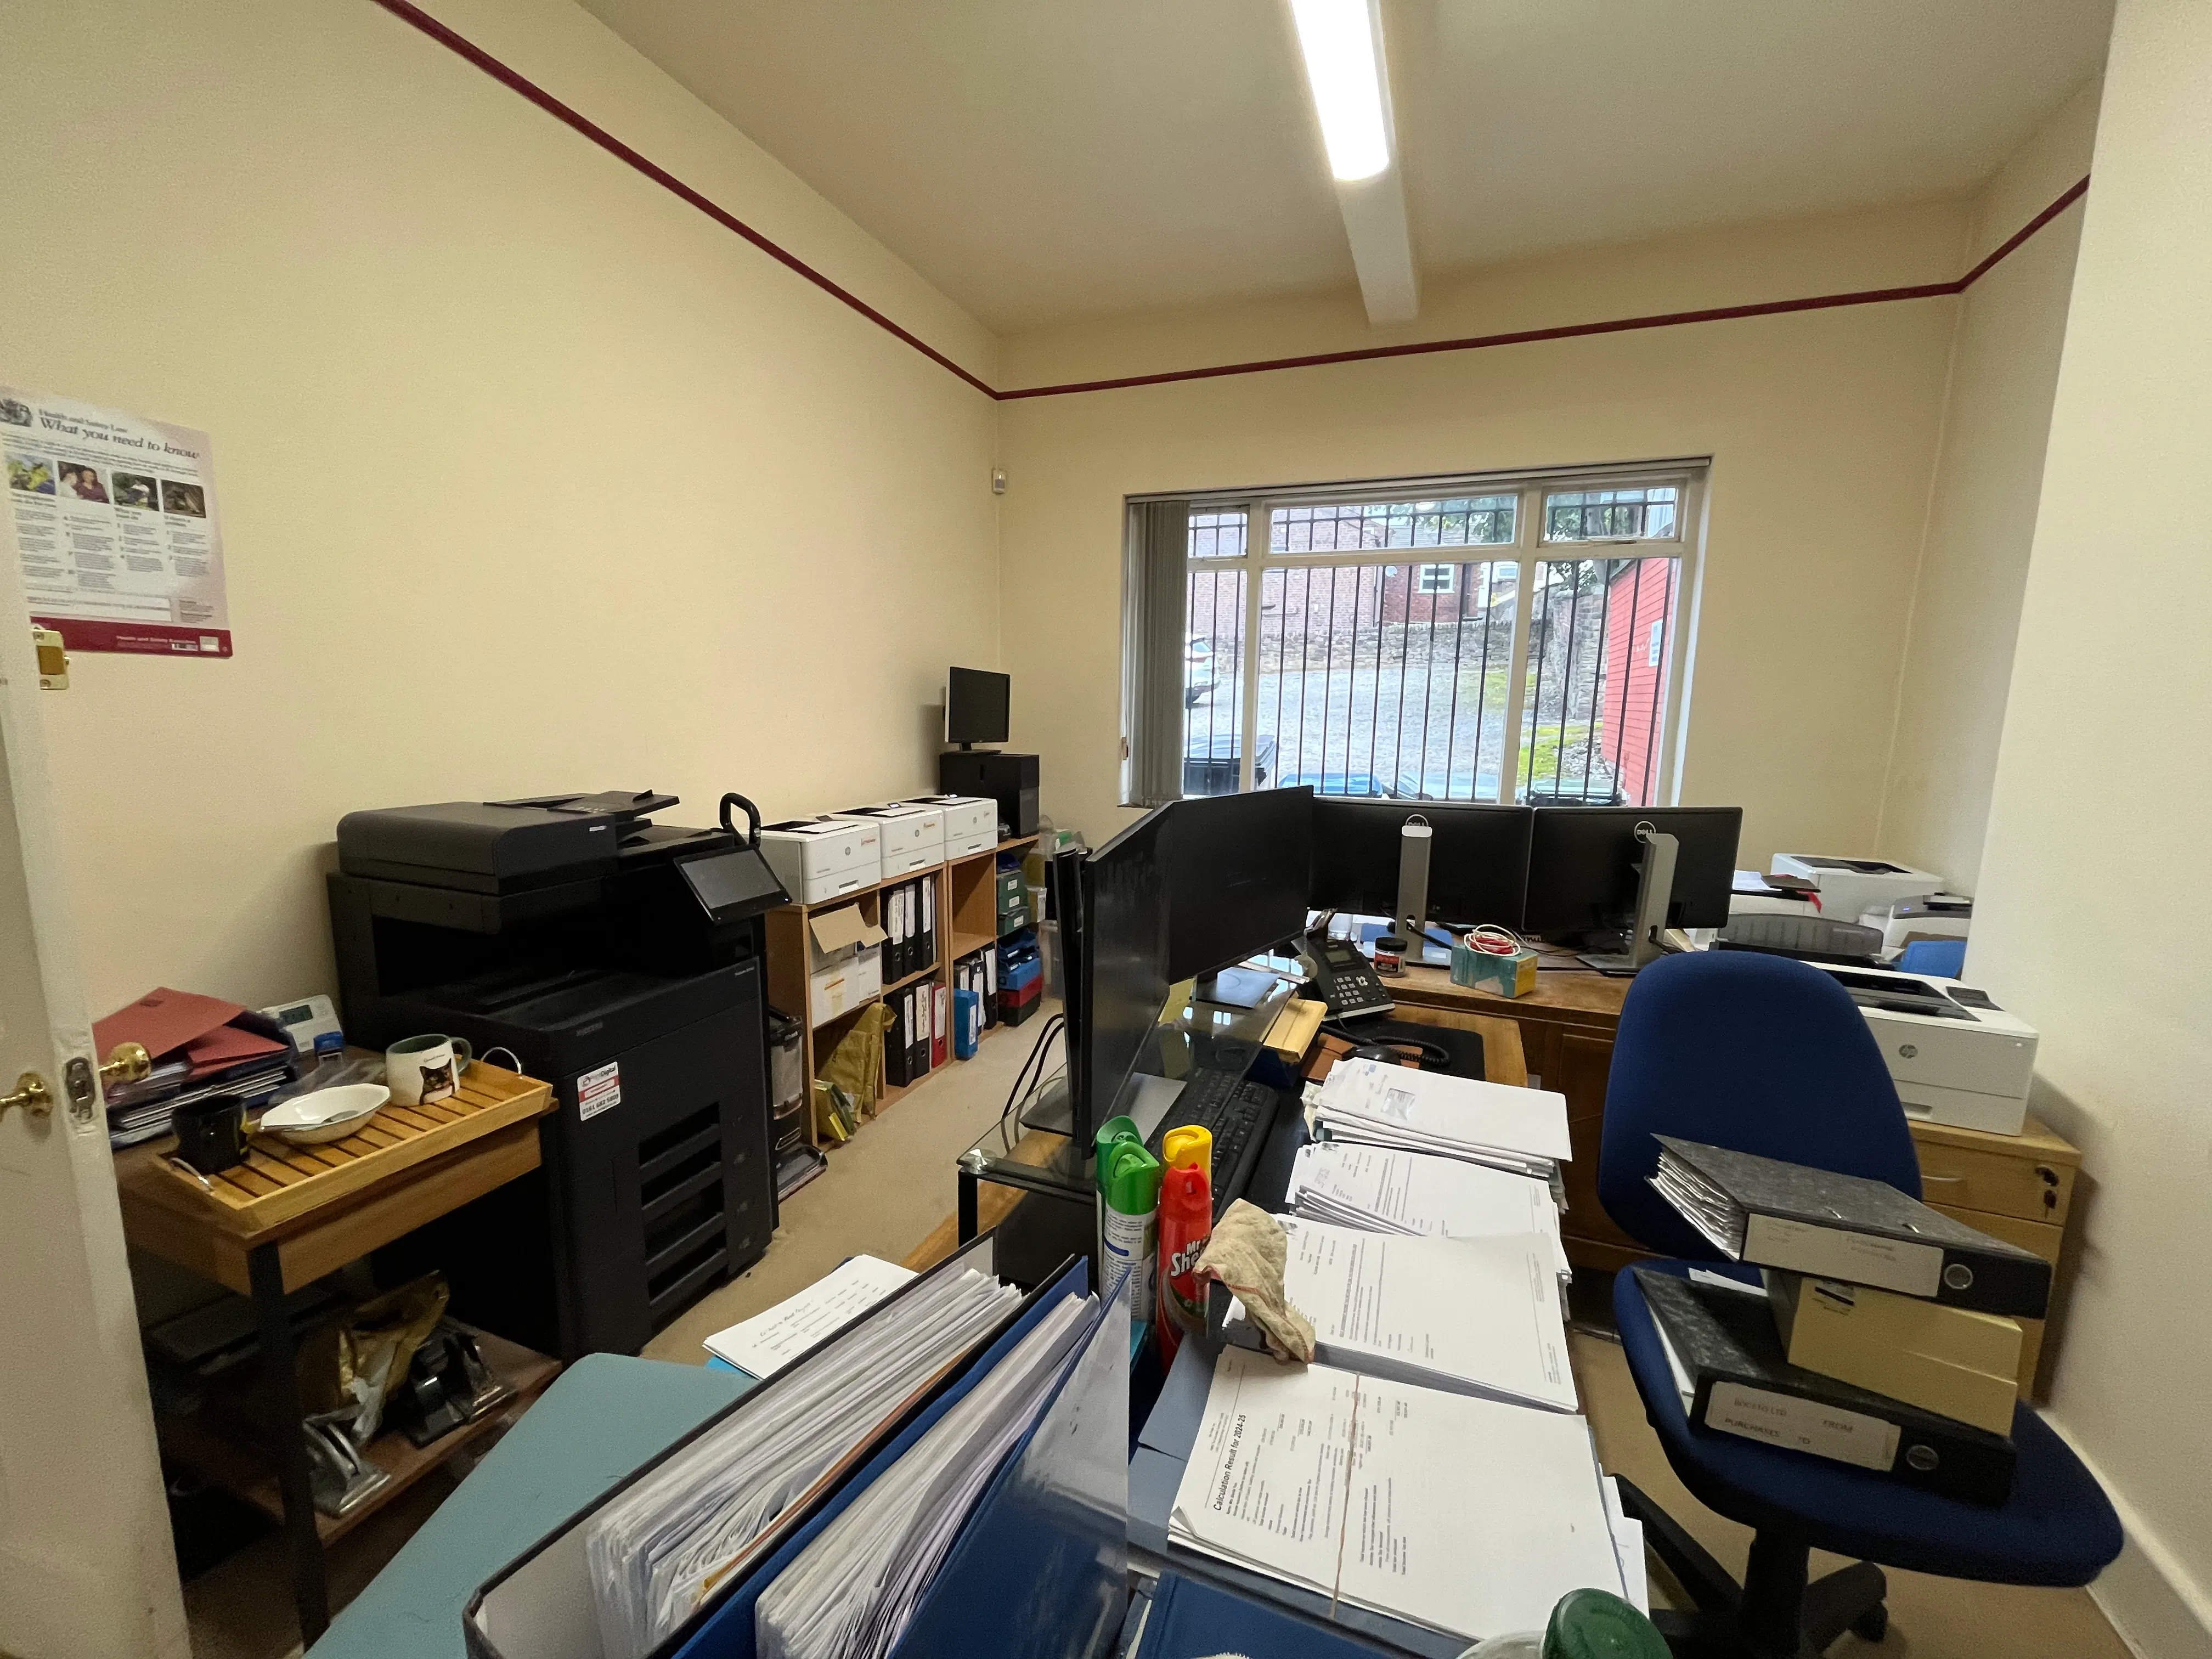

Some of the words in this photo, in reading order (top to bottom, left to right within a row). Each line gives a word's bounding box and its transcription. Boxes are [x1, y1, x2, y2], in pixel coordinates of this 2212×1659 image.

[41, 417, 78, 435] What
[82, 429, 109, 441] you
[112, 435, 144, 448] need
[148, 439, 160, 451] to
[163, 442, 200, 459] know
[1171, 1251, 1205, 1277] She
[1234, 1414, 1246, 1438] 2024-25
[1725, 1417, 1780, 1438] PURCHASES
[1231, 1438, 1240, 1448] for
[1224, 1448, 1237, 1470] Result
[1214, 1471, 1231, 1510] Calculation
